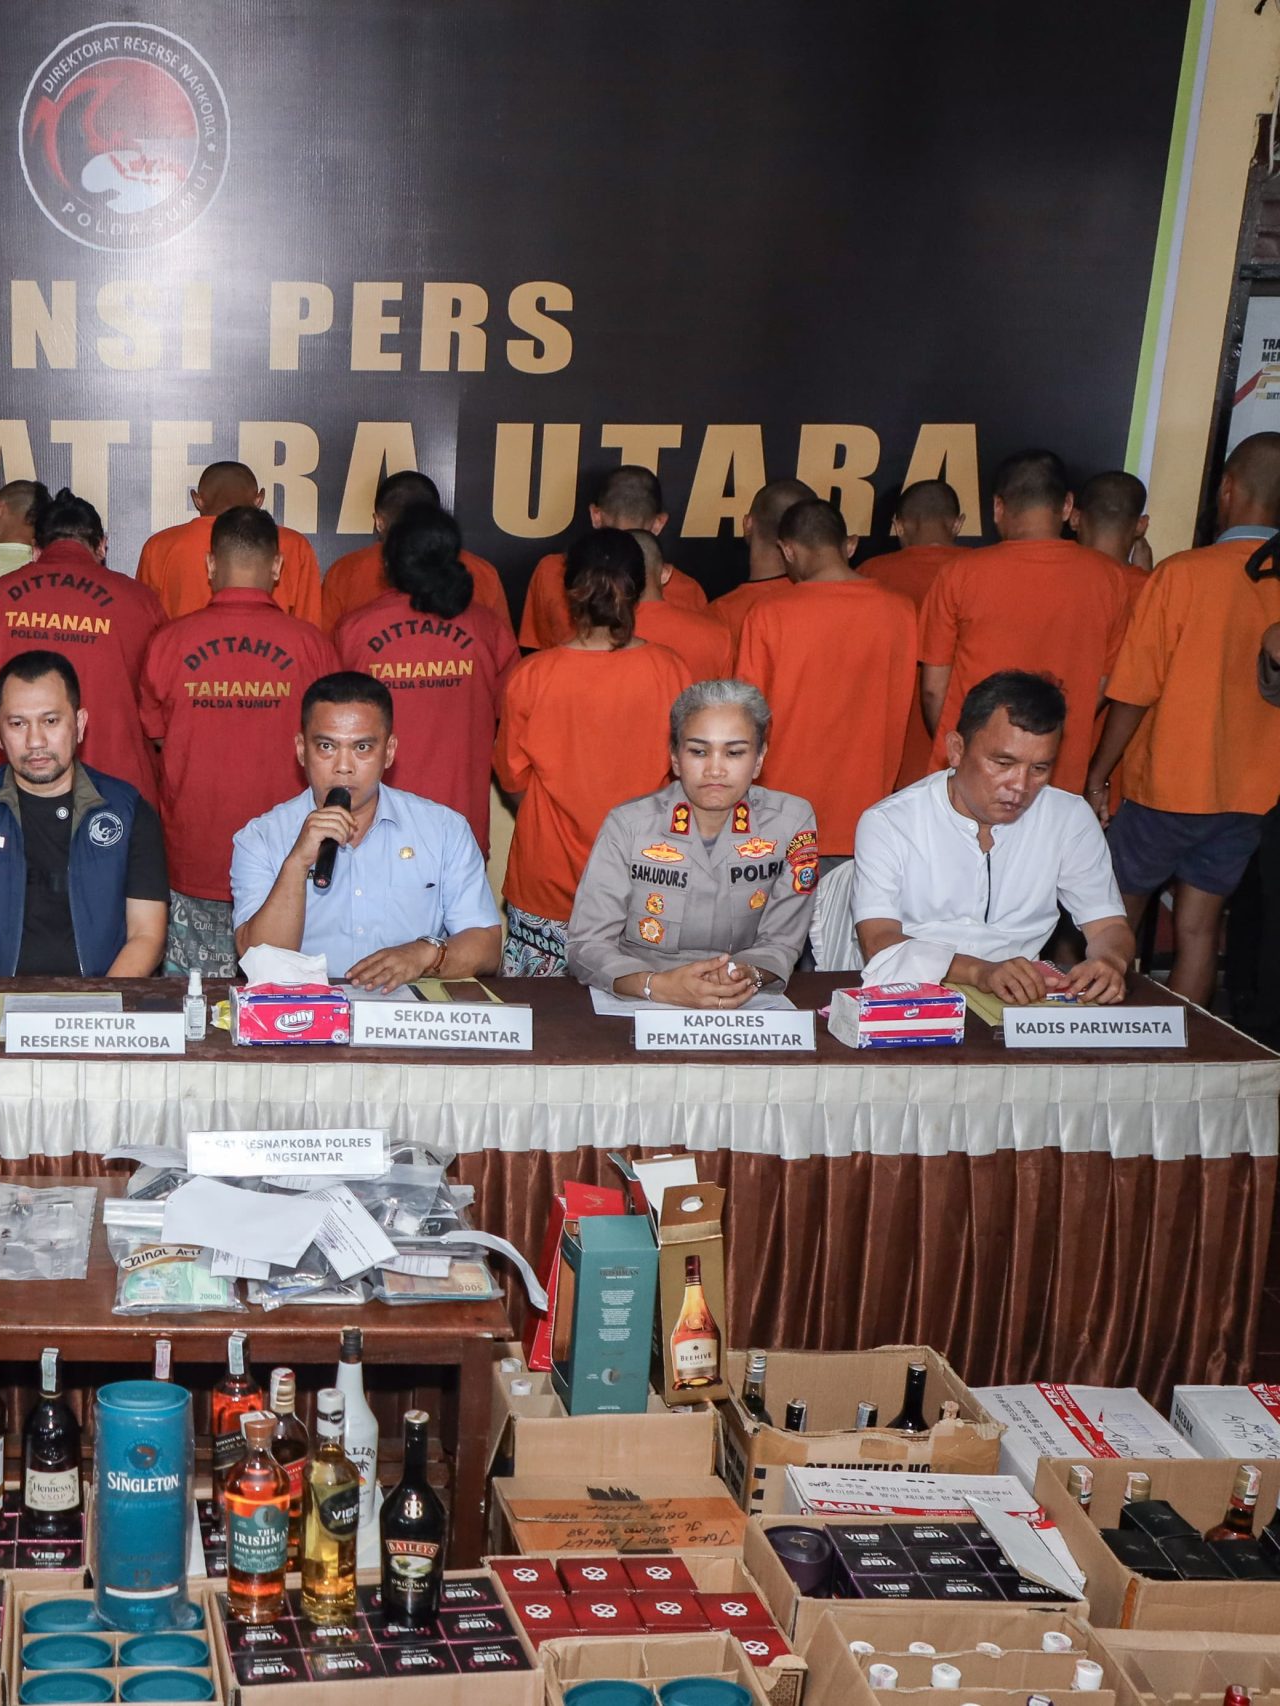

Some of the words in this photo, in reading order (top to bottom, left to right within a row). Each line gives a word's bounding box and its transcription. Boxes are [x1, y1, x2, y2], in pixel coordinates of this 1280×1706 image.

[41, 36, 119, 93] DIREKTORAT
[123, 36, 180, 66] RESERSE
[178, 61, 216, 139] NARKOBA
[62, 202, 139, 235] POLDA
[150, 158, 214, 229] SUMUT
[269, 281, 575, 374] PERS
[6, 572, 115, 608] DITTAHTI
[5, 611, 111, 634] TAHANAN
[10, 629, 49, 641] POLDA
[52, 632, 98, 645] SUMUT
[367, 619, 474, 654] DITTAHTI
[184, 636, 294, 673] DITTAHTI
[368, 659, 473, 679] TAHANAN
[184, 681, 291, 698] TAHANAN
[421, 676, 463, 690] SUMUT
[192, 699, 233, 710] POLDA
[236, 699, 281, 710] SUMUT
[730, 860, 784, 883] POLRI
[55, 1017, 136, 1031] DIREKTUR
[284, 1011, 313, 1026] Jolly
[394, 1009, 445, 1024] SEKDA
[449, 1010, 492, 1025] KOTA
[683, 1015, 765, 1029] KAPOLRES
[365, 1026, 520, 1044] PEMATANGSIANTAR
[1015, 1021, 1073, 1036] KADIS
[1077, 1021, 1173, 1036] PARIWISATA
[20, 1035, 90, 1049] RESERSE
[94, 1034, 170, 1049] NARKOBA
[647, 1032, 803, 1047] PEMATANGSIANTAR
[326, 1138, 372, 1148] POLRES
[680, 1352, 712, 1362] BEEHIVE
[108, 1472, 179, 1493] SINGLETON
[257, 1528, 275, 1536] THE
[389, 1541, 435, 1554] BAILEYS
[391, 1578, 429, 1588] ORIGINAL
